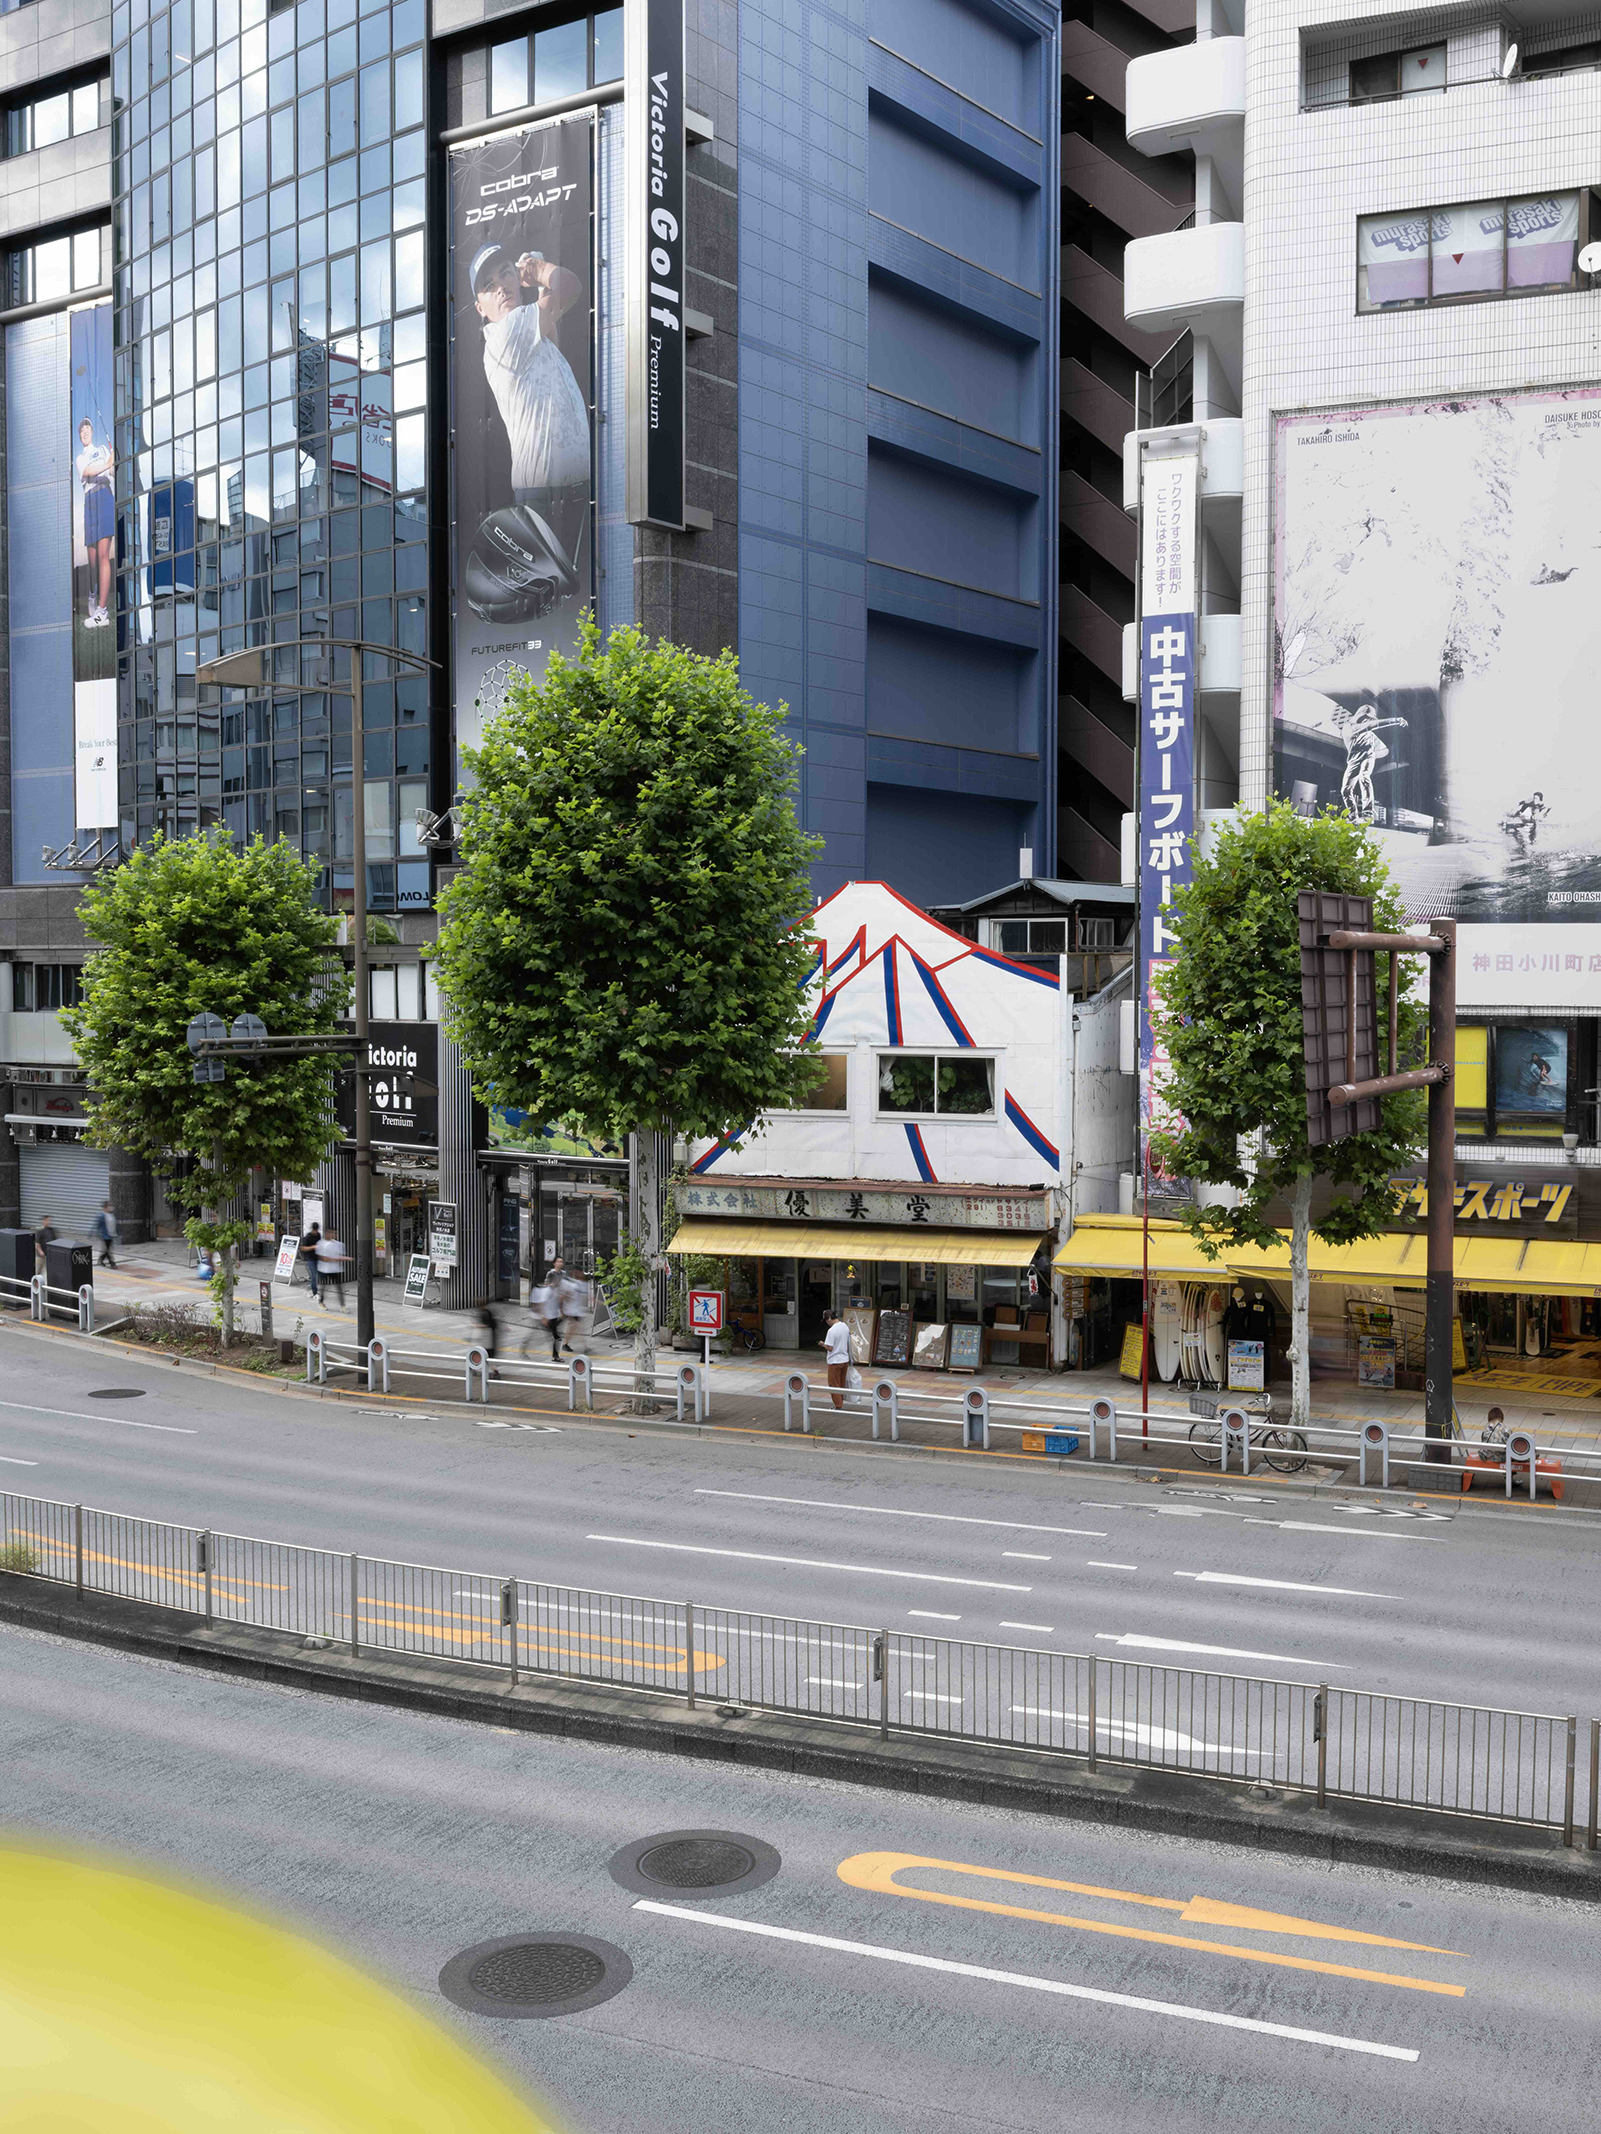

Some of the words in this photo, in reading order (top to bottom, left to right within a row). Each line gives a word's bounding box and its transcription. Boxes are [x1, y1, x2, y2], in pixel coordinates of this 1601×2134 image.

[650, 72, 669, 197] Victoria
[480, 166, 557, 197] cobra
[465, 183, 577, 226] DS-ADAPT
[1479, 197, 1562, 233] murasaki
[1507, 209, 1565, 238] sports
[650, 206, 680, 331] Golf
[650, 336, 663, 430] Premium
[1545, 411, 1579, 424] DAISUKE
[1297, 434, 1333, 446] TAKAHIRO
[1335, 432, 1360, 443] ISHIDA
[494, 526, 534, 562] cobra
[1169, 473, 1183, 594] ワクワクする空間が
[471, 639, 542, 656] FUTUREFIT33
[1549, 892, 1572, 902] KAITO
[368, 1043, 417, 1068] ictoria
[382, 1114, 414, 1128] Premium
[687, 1191, 757, 1208] 株式会社
[409, 1272, 426, 1284] SALE
